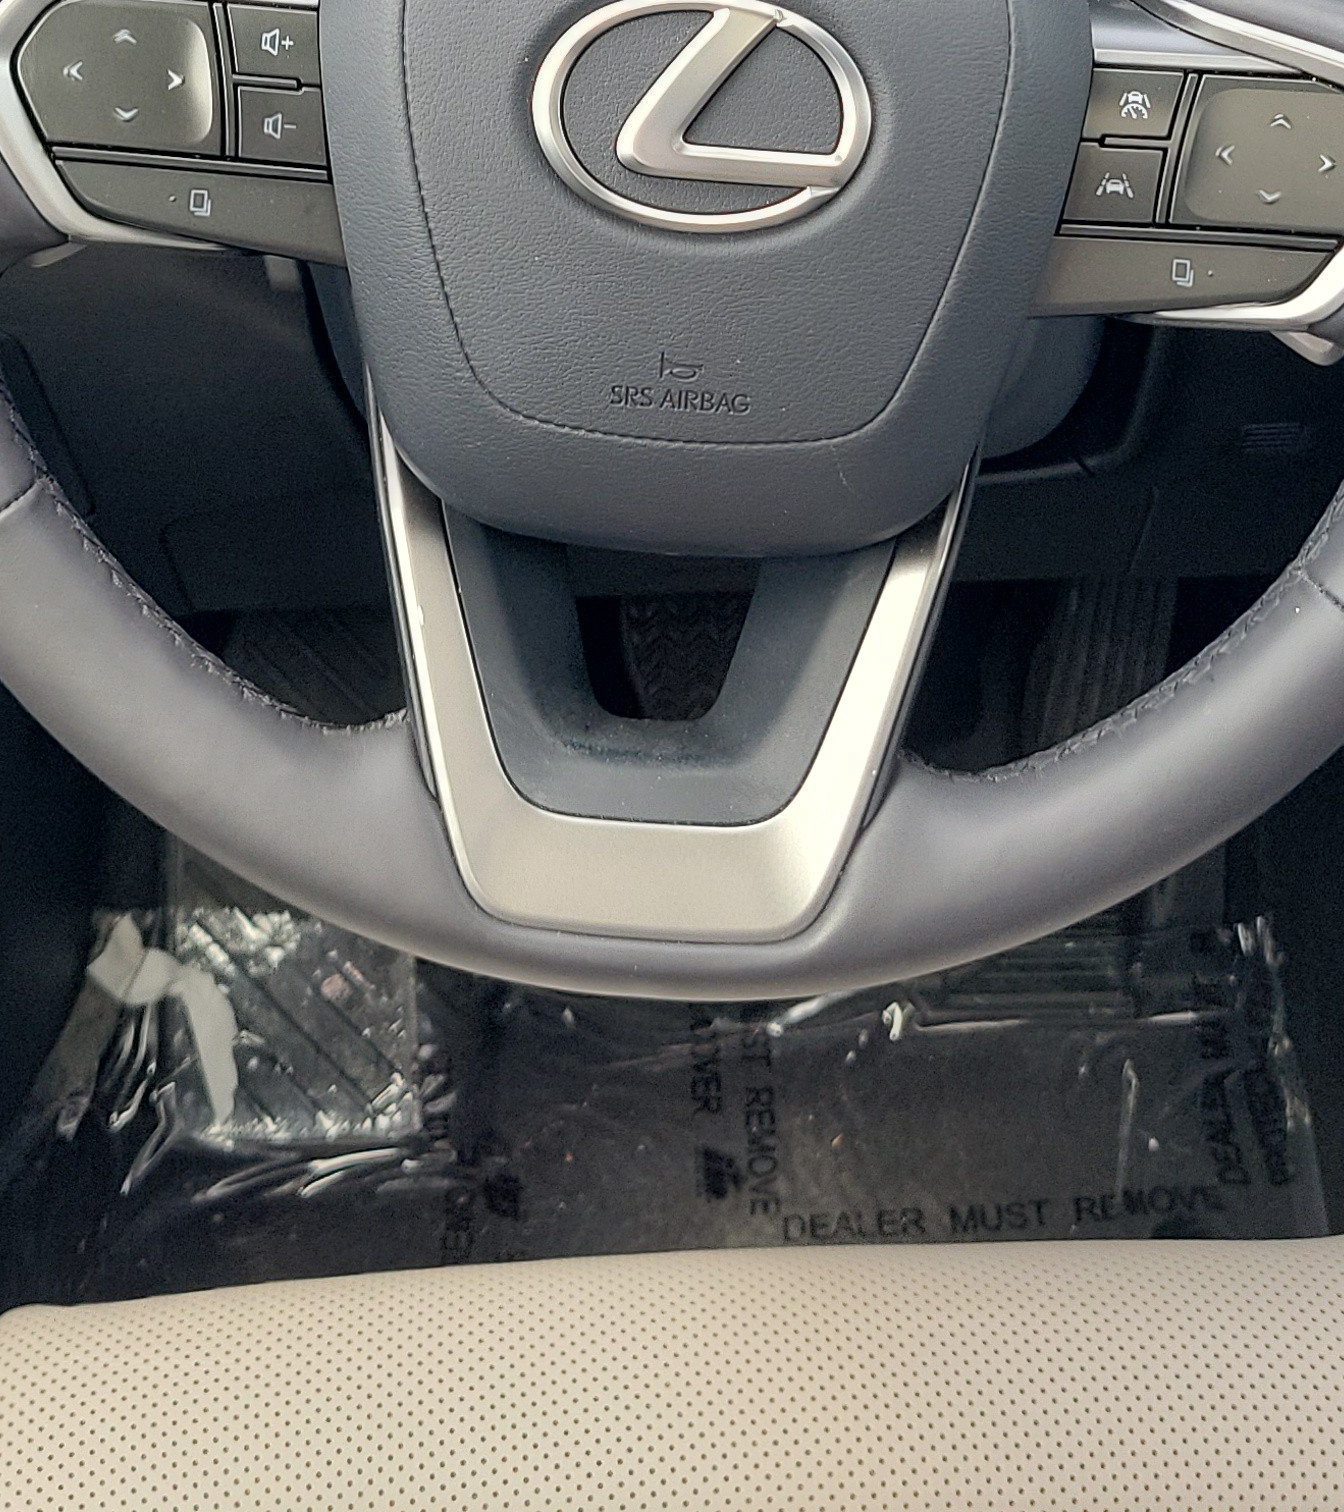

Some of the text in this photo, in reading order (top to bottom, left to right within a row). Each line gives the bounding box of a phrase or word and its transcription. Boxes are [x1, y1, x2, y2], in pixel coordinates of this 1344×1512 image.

[609, 385, 752, 415] SRS AIRBAG
[781, 1206, 926, 1243] DEALER
[949, 1197, 1048, 1235] MUST
